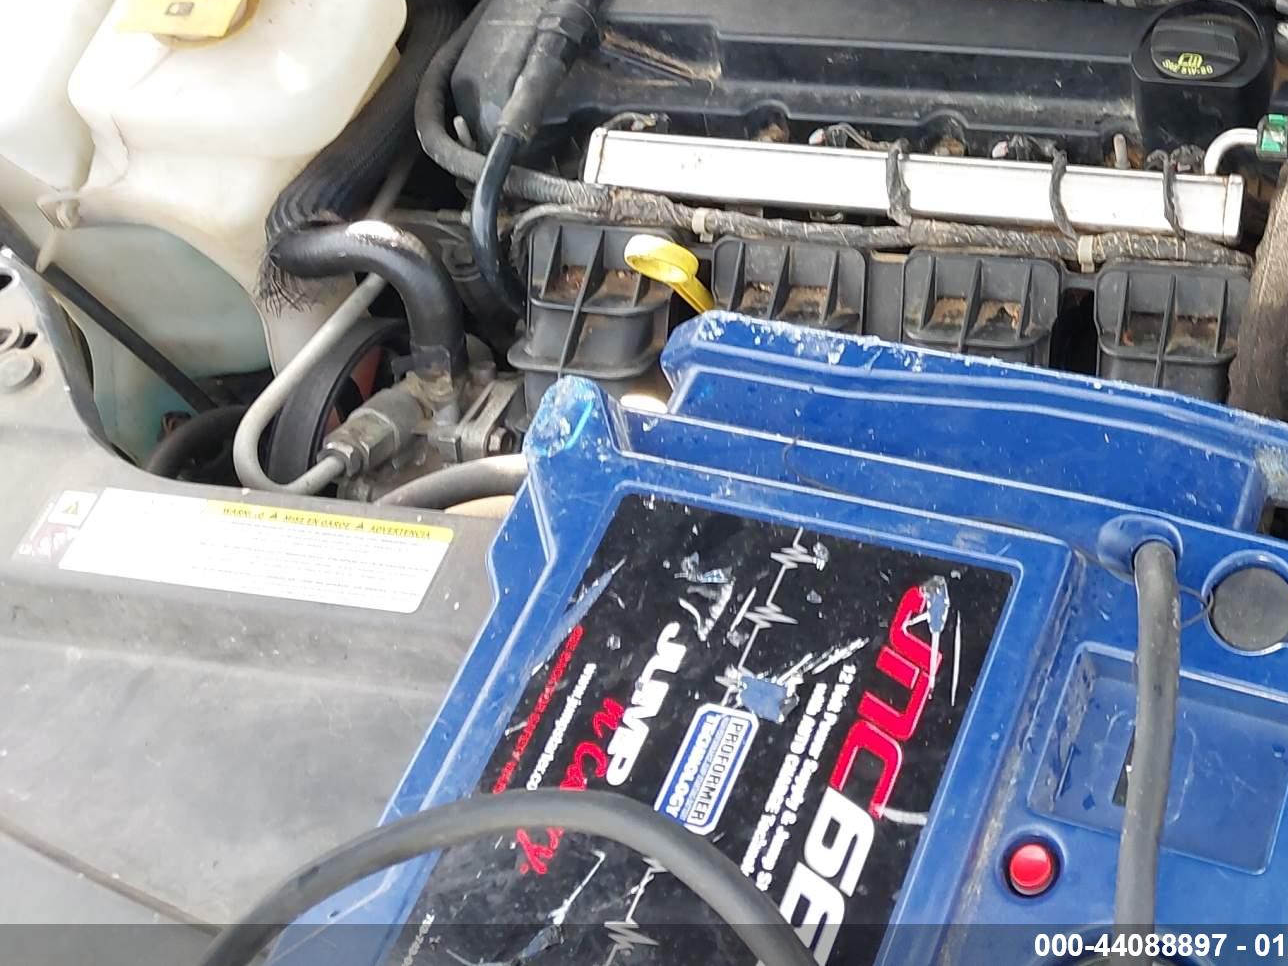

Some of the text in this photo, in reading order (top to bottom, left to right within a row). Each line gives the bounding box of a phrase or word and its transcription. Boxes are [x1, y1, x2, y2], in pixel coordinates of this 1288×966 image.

[526, 662, 596, 790] www.jumpstarter.co
[605, 621, 687, 785] JUMP
[838, 664, 856, 684] 12
[661, 710, 722, 819] TECHNOLOGY
[688, 720, 746, 822] PROFORMER
